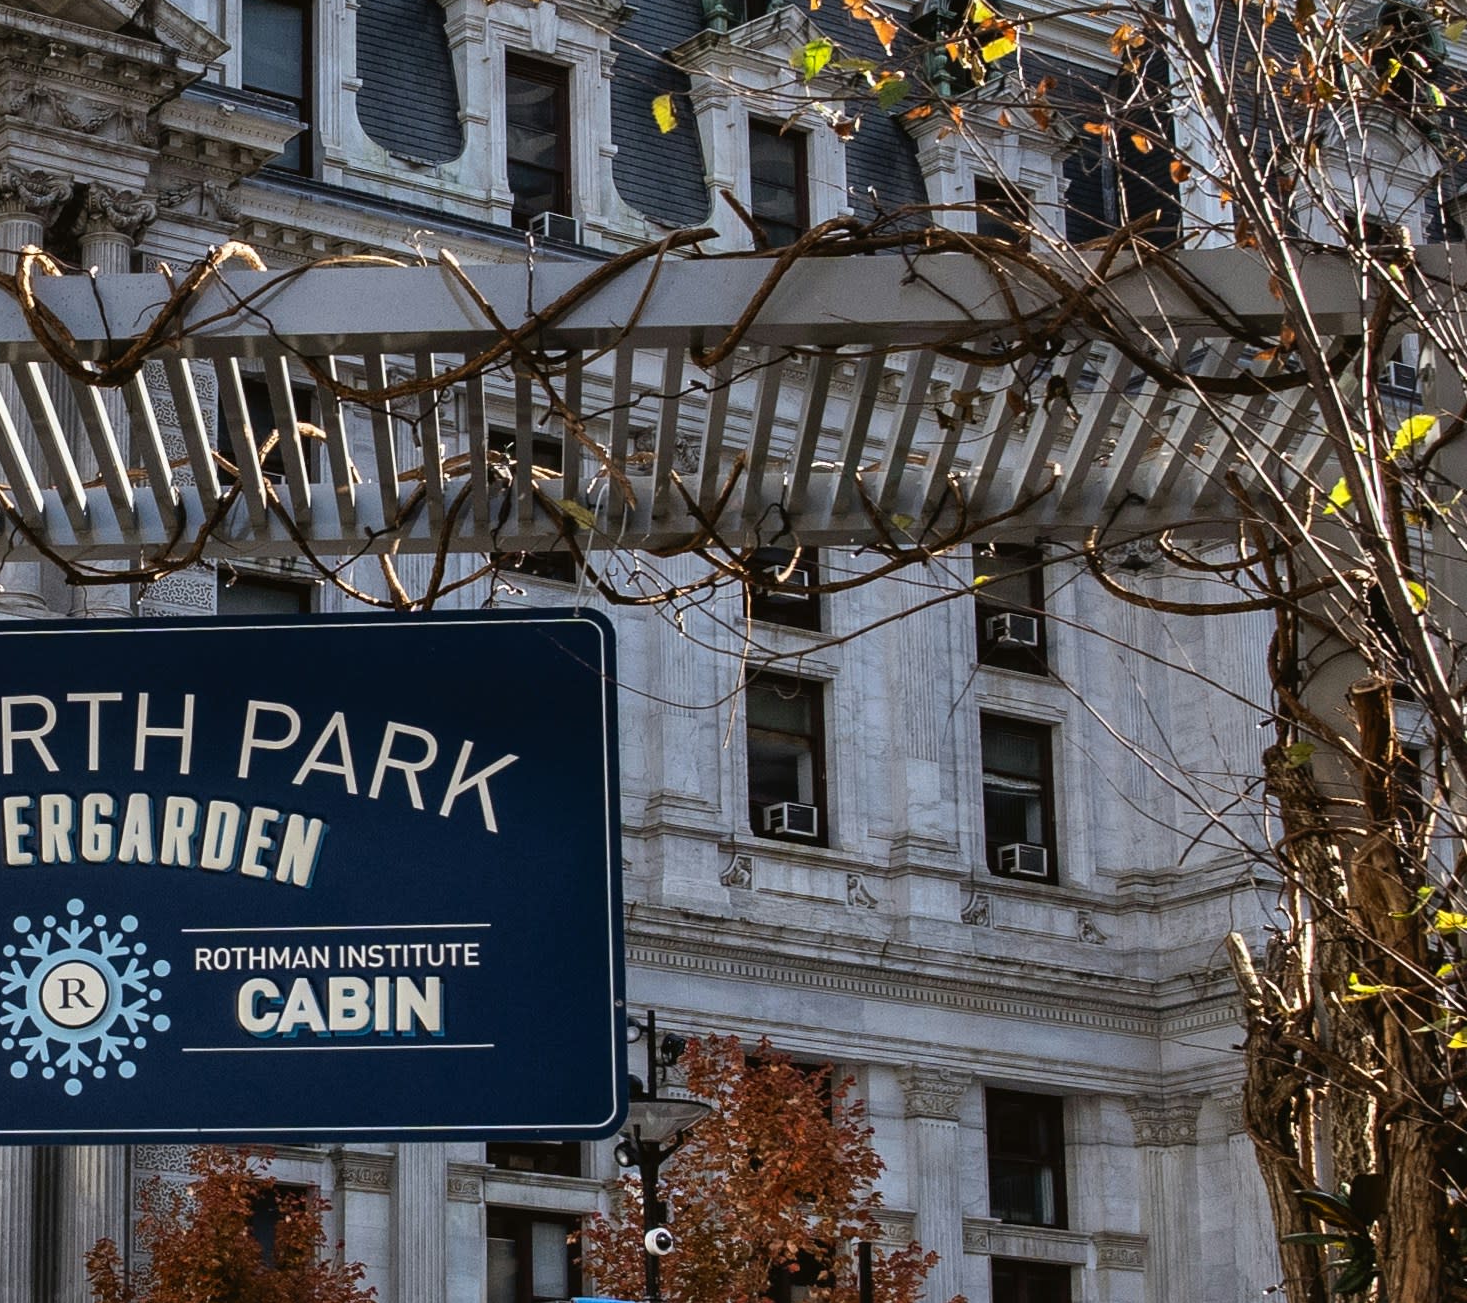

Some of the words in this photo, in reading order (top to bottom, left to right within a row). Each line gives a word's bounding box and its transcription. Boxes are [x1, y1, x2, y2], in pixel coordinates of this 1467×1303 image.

[238, 700, 519, 833] PARK
[195, 946, 330, 971] ROTHMAN
[339, 943, 480, 969] INSTITUTE
[56, 977, 94, 1012] R
[238, 976, 443, 1034] CABIN
